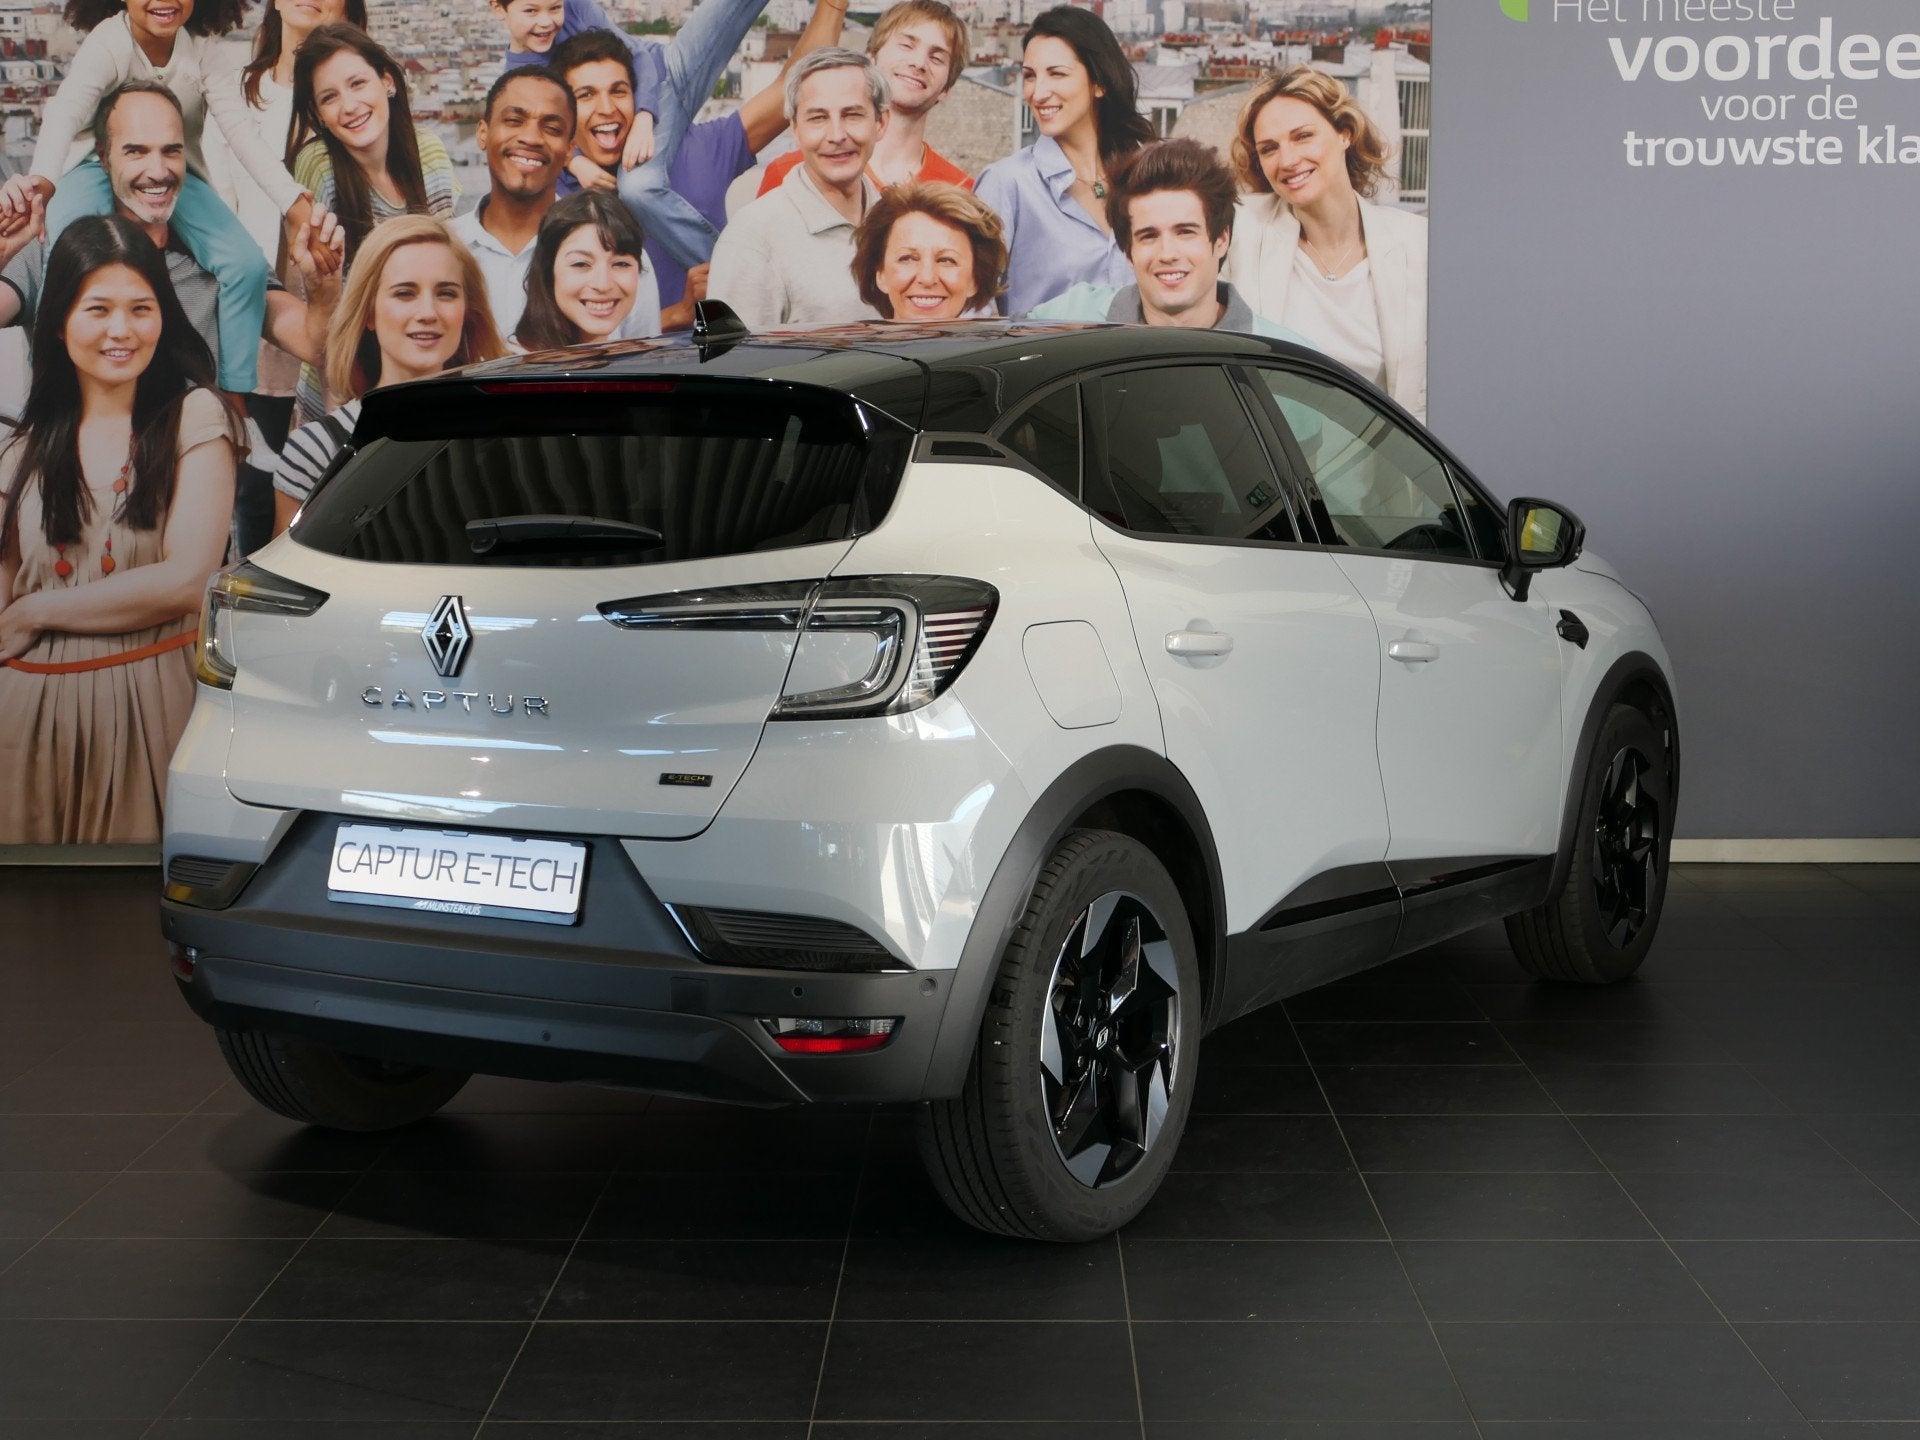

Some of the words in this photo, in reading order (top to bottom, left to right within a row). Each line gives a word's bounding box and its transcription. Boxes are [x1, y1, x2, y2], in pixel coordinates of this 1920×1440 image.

[1553, 0, 1628, 23] Het
[1642, 0, 1796, 22] meeste
[1607, 16, 1920, 82] voordee
[1700, 94, 1796, 121] voor
[1806, 84, 1858, 120] de
[1622, 129, 1843, 166] trouwste
[1857, 124, 1920, 165] kla
[361, 685, 550, 718] CAPTUR
[668, 774, 705, 782] E-TECH
[336, 841, 457, 882] CAPTUR
[463, 852, 578, 894] E-TECH
